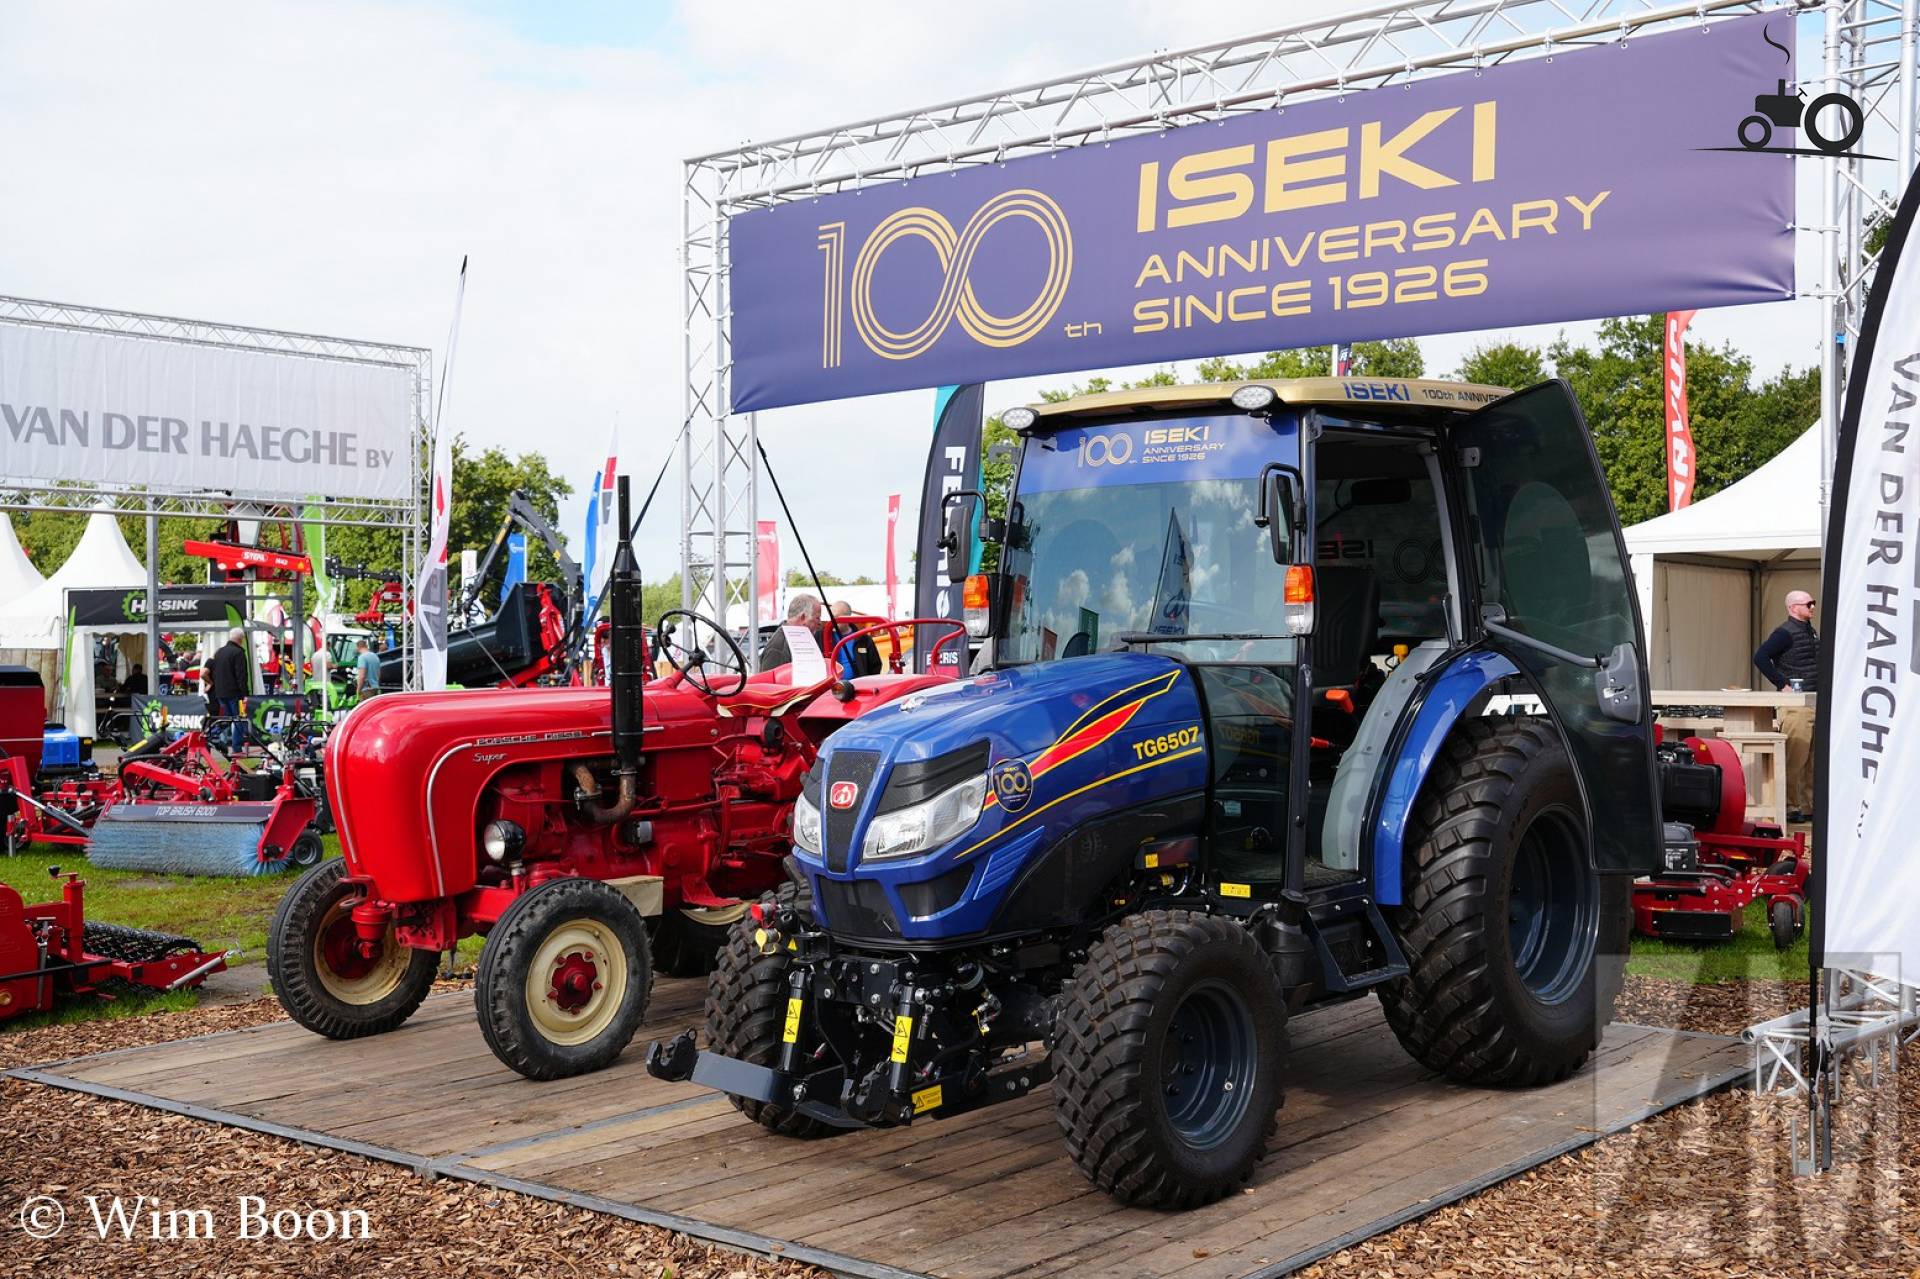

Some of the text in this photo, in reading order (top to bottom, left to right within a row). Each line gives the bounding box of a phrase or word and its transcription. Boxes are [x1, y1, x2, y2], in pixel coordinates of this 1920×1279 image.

[1135, 100, 1498, 234] ISEKI
[1134, 190, 1611, 289] ANNIVERSARY
[1132, 257, 1490, 333] SINCE 1926
[1343, 382, 1411, 401] ISEKI
[1422, 388, 1455, 401] 100th
[0, 403, 394, 469] VAN DER HAEGHE BV
[1144, 425, 1210, 445] ISEKI
[1077, 431, 1133, 468] 100
[1141, 455, 1176, 464] SINCE
[1177, 452, 1206, 462] 1926
[1143, 442, 1226, 455] ANNIVERSARY
[1860, 353, 1920, 785] VAN DER HAEGHE
[477, 734, 537, 747] PORSCHE
[1132, 725, 1200, 760] TG6507
[473, 753, 506, 764] Super
[994, 771, 1028, 795] 100
[155, 806, 170, 816] TOP
